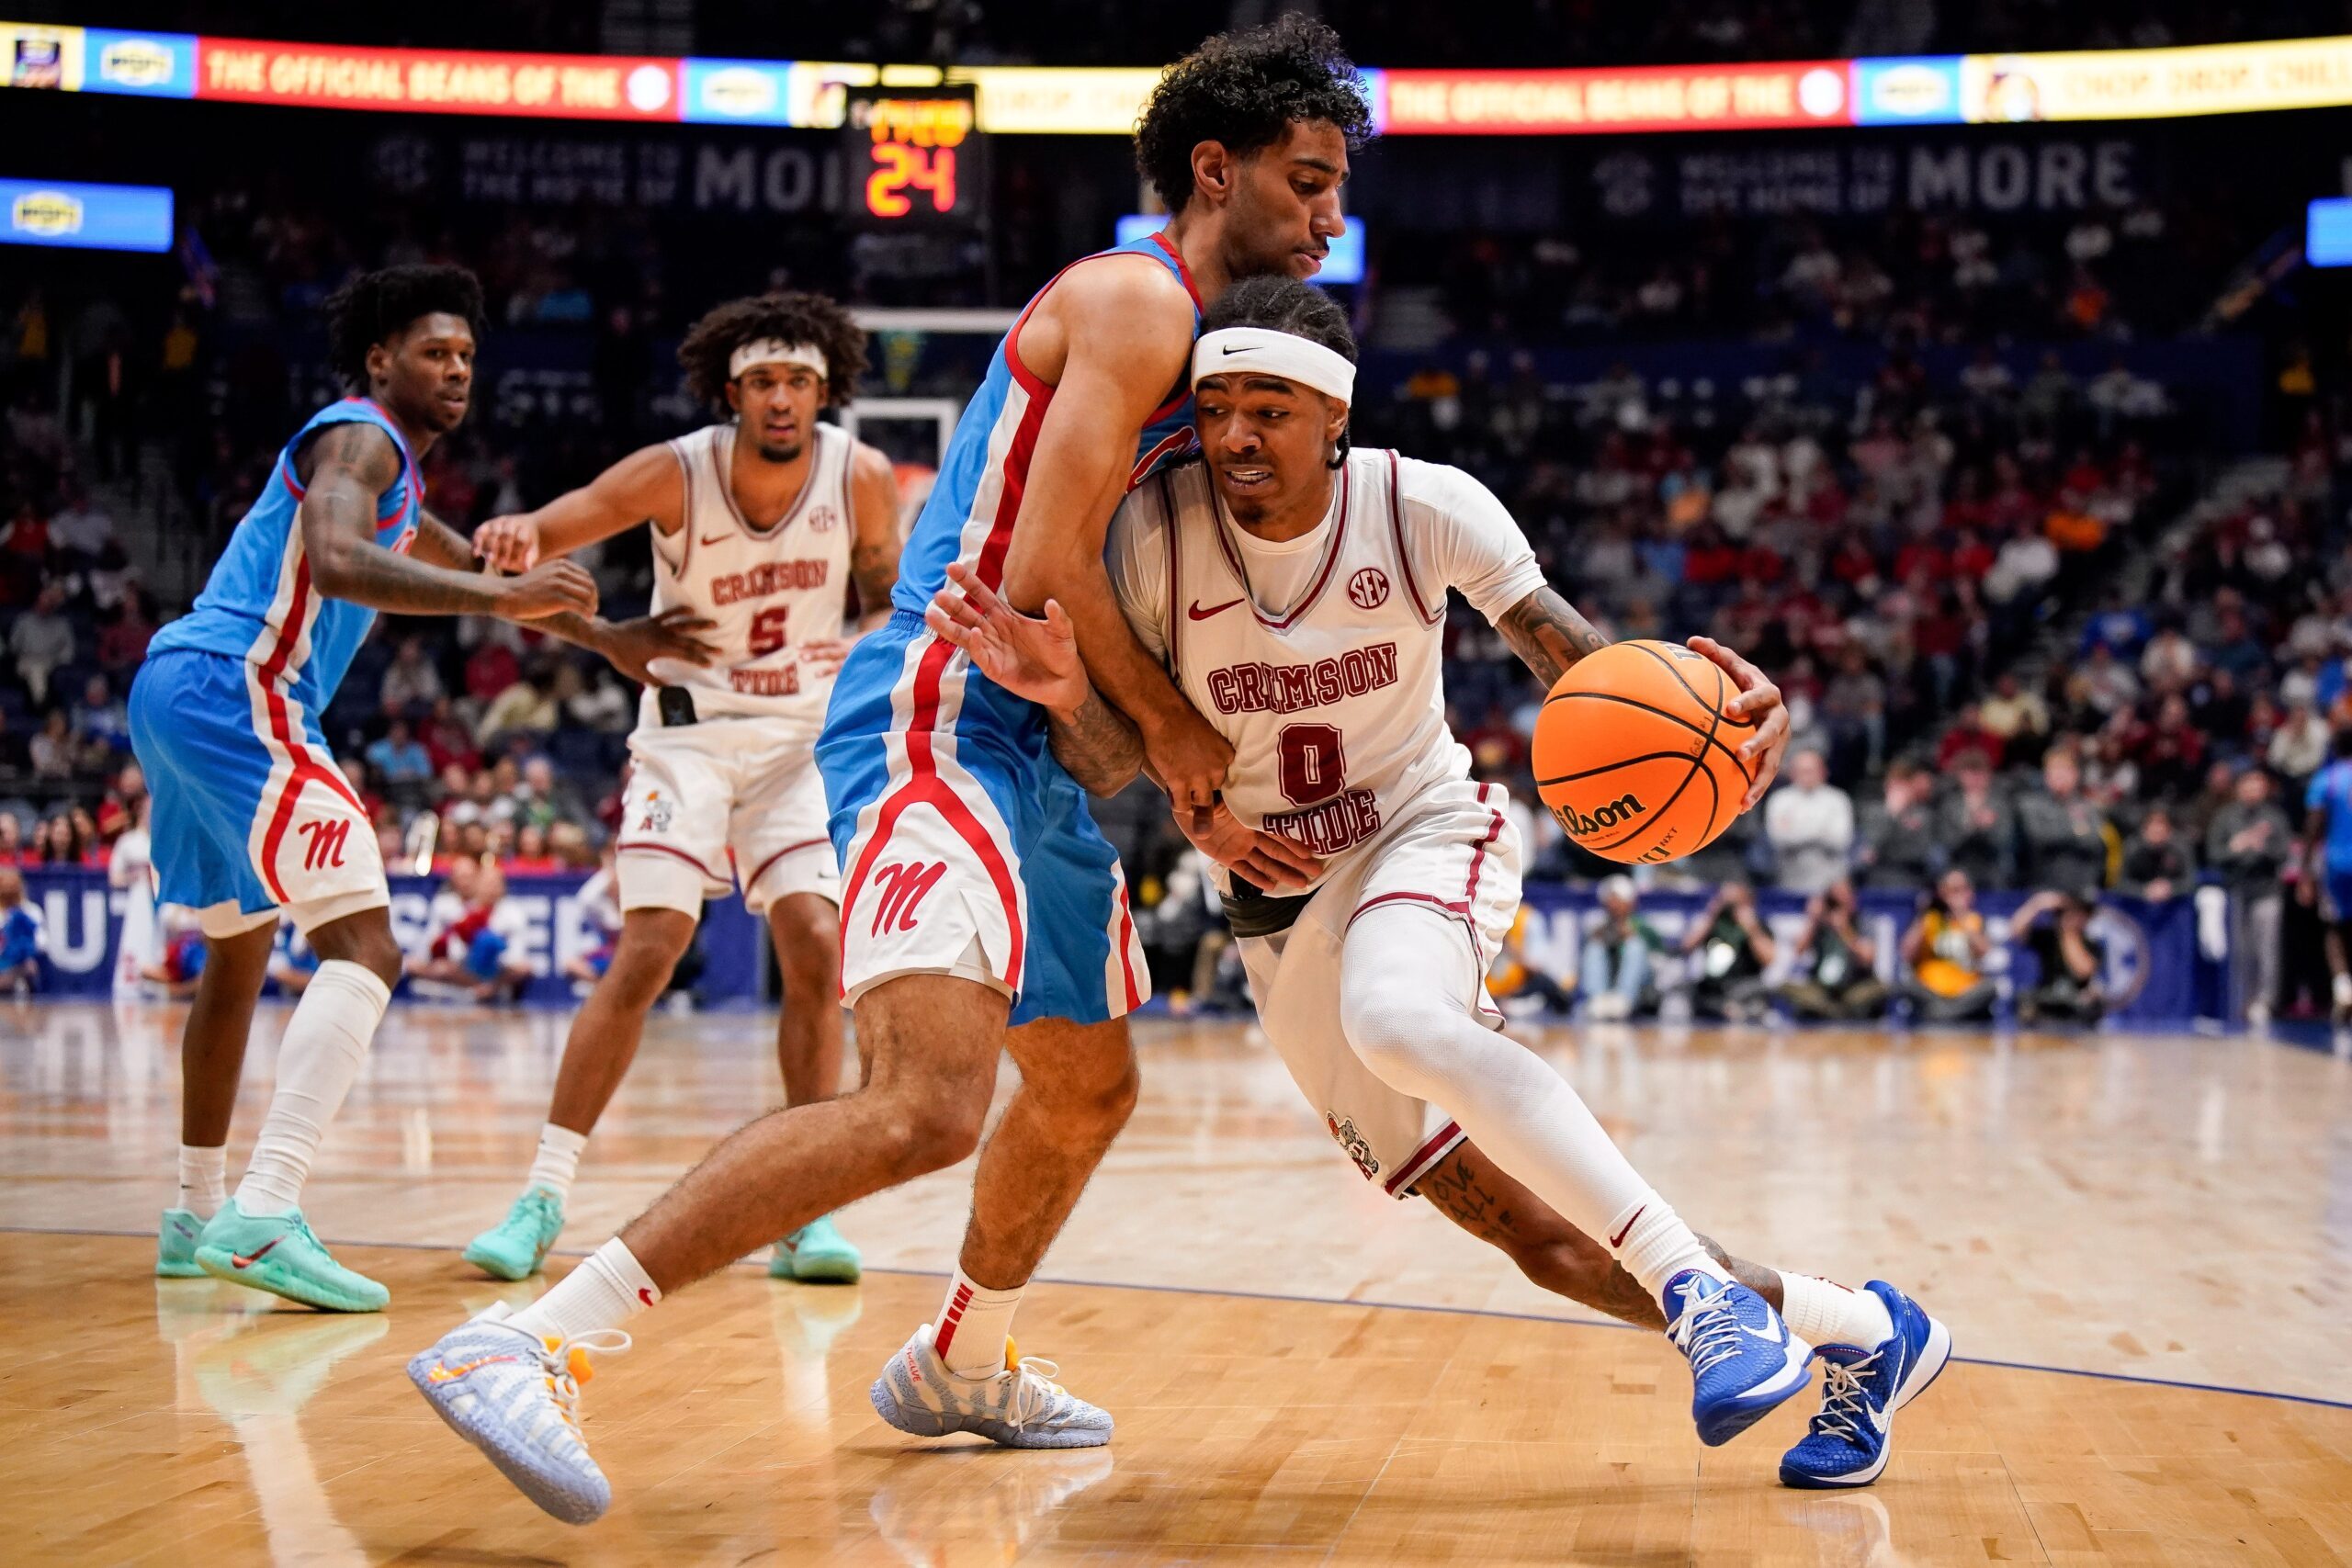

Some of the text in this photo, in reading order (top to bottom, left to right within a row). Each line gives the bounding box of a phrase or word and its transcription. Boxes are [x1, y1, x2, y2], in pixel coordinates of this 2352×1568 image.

[208, 50, 622, 109] THE OFFICIAL BEANS OF THE
[1450, 79, 1585, 123] OFFICIAL
[866, 141, 956, 217] 24
[1907, 141, 2136, 211] MORE
[709, 558, 830, 605] CRIMSON
[1349, 568, 1388, 608] SEC
[748, 604, 790, 658] 5
[728, 662, 799, 697] TIDE
[1206, 641, 1398, 715] CRIMSON
[1276, 722, 1348, 807] 0
[1261, 788, 1381, 856] TIDE
[1548, 793, 1647, 836] ilson
[1659, 827, 1679, 847] NXT
[298, 818, 351, 872] M
[870, 861, 948, 939] M
[906, 1344, 922, 1382] TWELVE
